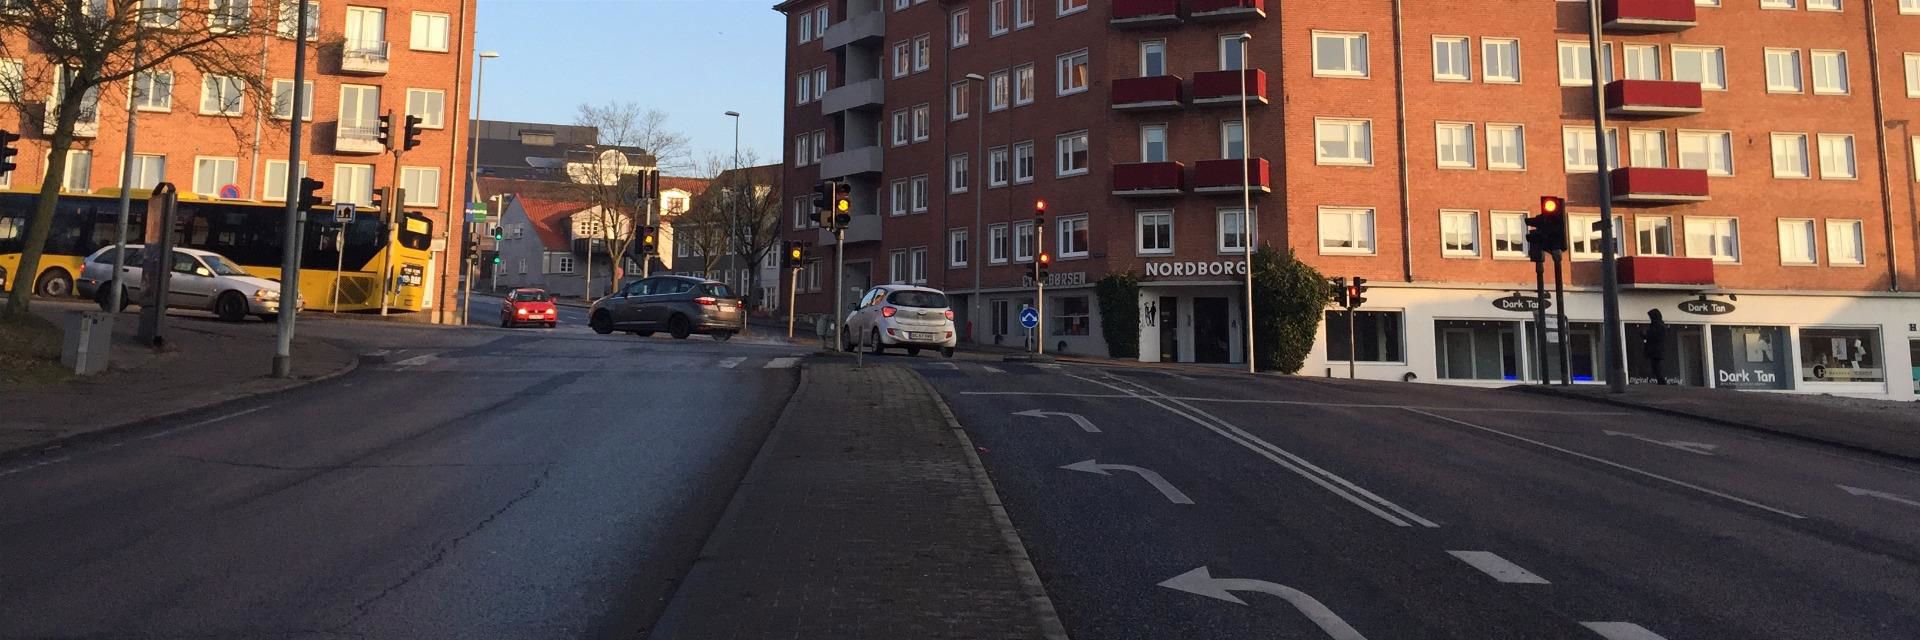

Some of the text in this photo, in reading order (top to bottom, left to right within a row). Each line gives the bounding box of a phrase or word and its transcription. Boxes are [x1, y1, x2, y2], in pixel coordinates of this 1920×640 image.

[1145, 261, 1246, 276] NORDBORG
[1502, 299, 1524, 309] Dark
[1687, 303, 1726, 313] Dark Tan
[1719, 368, 1776, 382] Dark Tan
